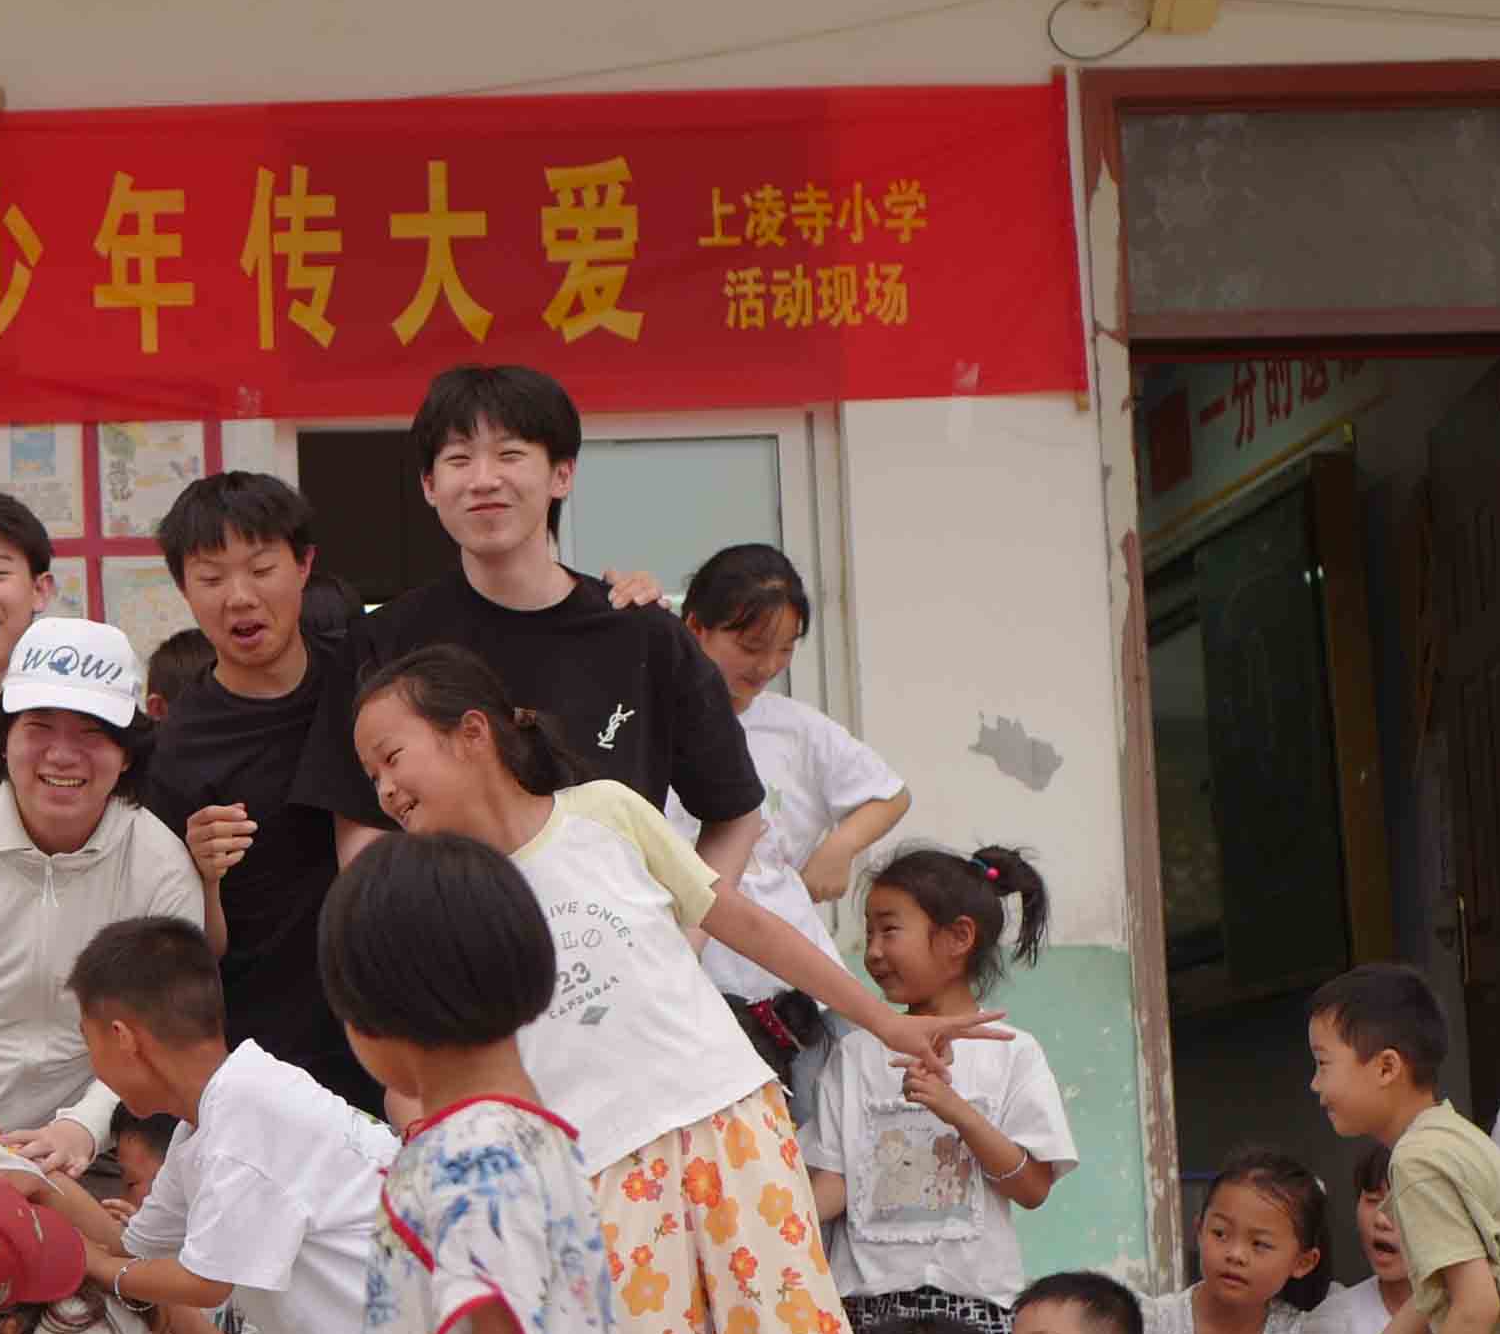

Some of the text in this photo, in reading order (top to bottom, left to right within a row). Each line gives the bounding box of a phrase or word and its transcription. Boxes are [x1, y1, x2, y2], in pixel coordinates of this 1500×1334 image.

[698, 179, 928, 248] 上凌寺小学
[723, 263, 909, 330] 活动现场
